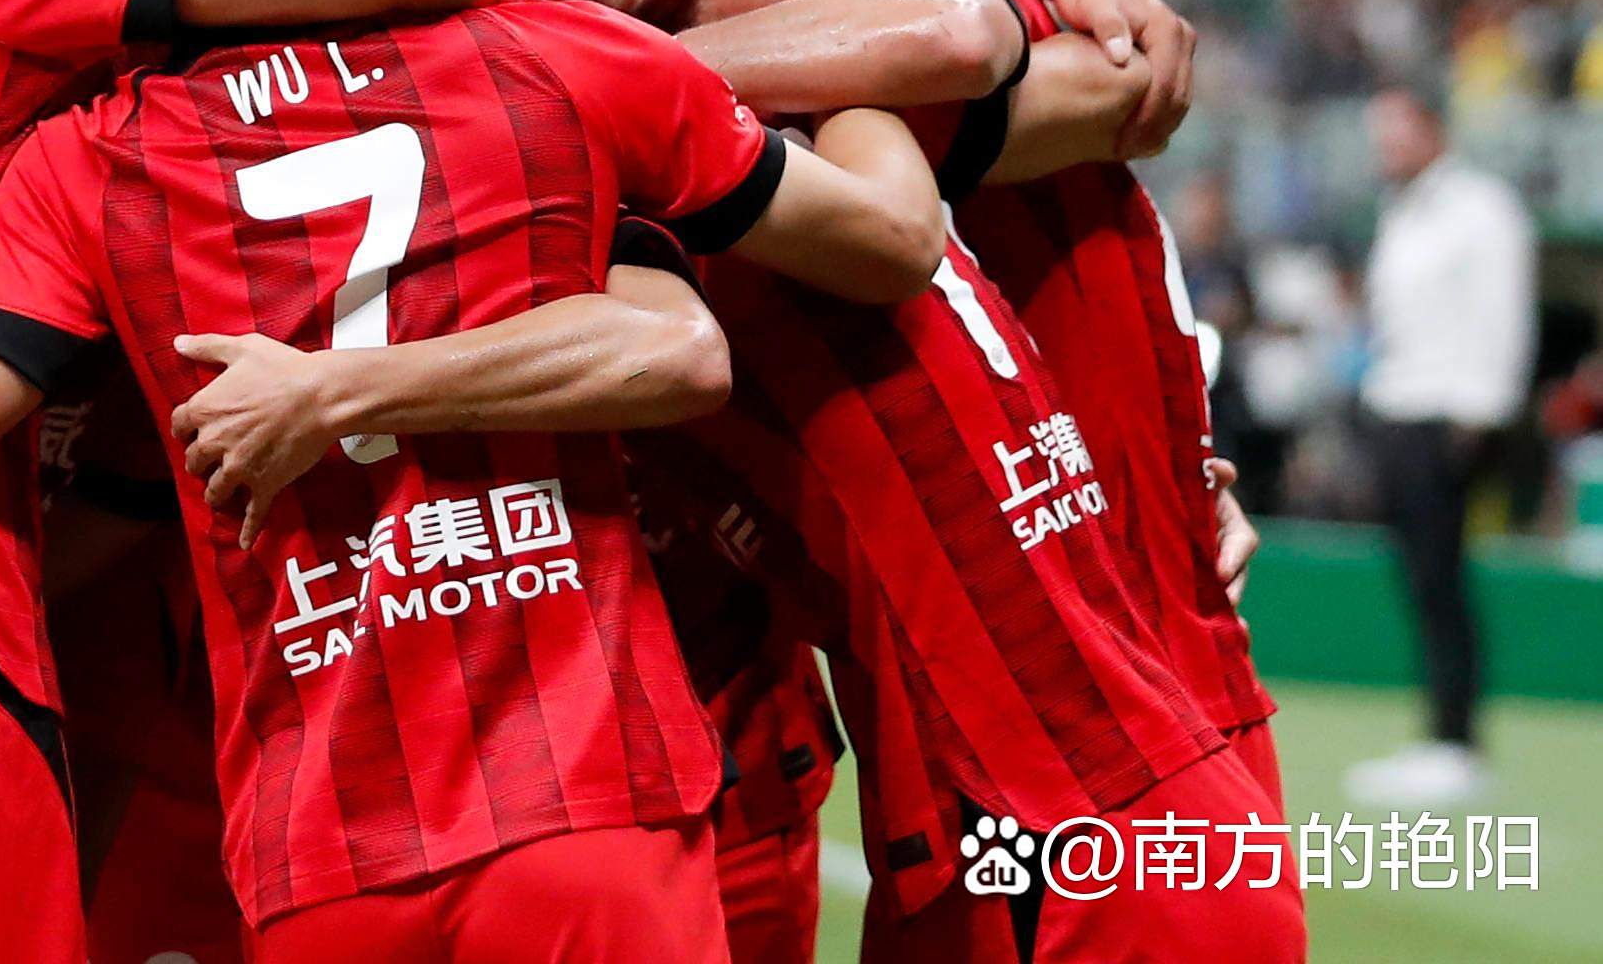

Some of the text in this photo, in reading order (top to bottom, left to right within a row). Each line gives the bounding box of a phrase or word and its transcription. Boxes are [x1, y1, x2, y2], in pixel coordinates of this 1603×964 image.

[223, 42, 384, 125] WU L.
[235, 122, 426, 465] 7
[992, 412, 1094, 513] 上汽集
[273, 478, 573, 635] 上汽集团
[1012, 493, 1082, 552] SAIC
[282, 558, 584, 677] SA MOTOR
